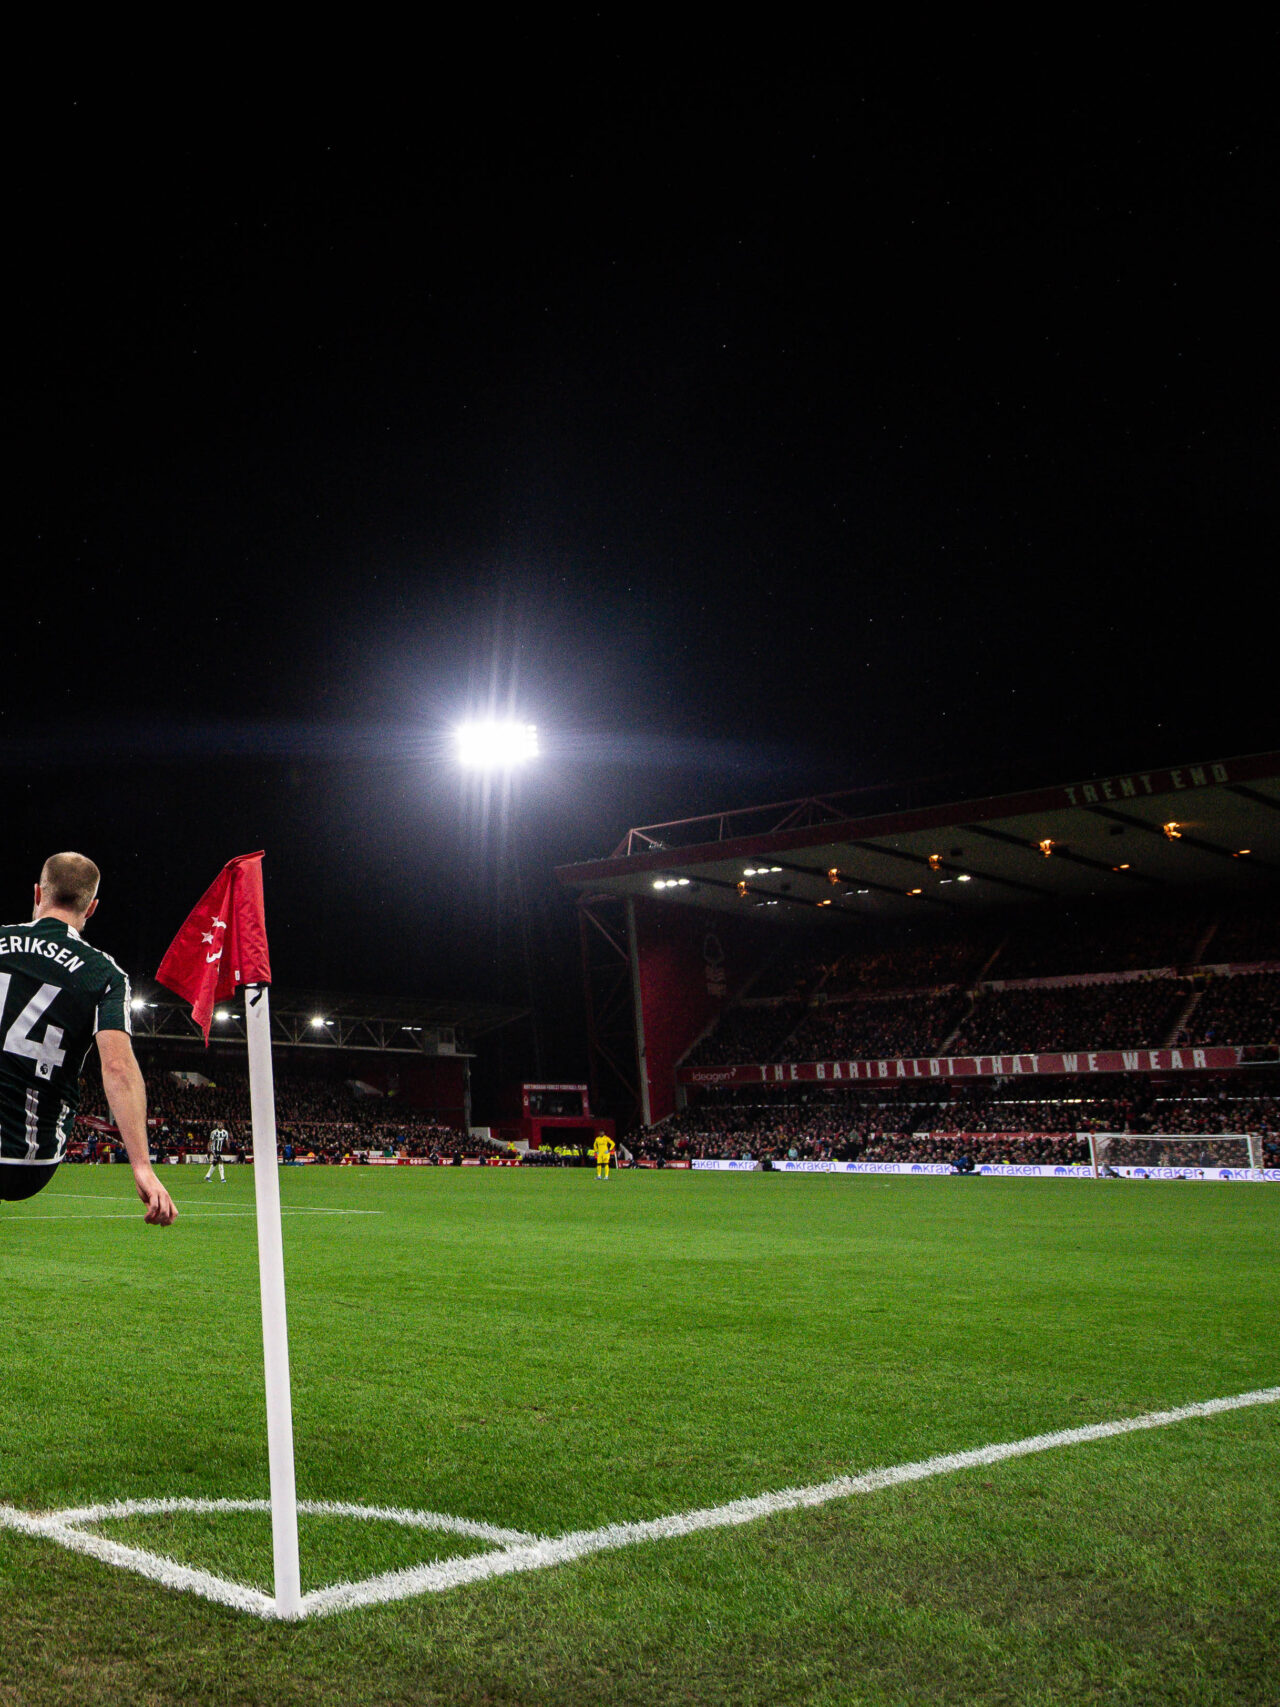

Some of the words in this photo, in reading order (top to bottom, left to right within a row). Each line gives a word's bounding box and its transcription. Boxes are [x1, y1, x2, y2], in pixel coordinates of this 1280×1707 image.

[1064, 775, 1153, 805] TRENT
[1169, 764, 1230, 789] END
[759, 1064, 799, 1081] THE
[816, 1058, 956, 1080] GARIBALDI
[973, 1056, 1040, 1075] THAT
[1062, 1053, 1099, 1072] WE
[1122, 1049, 1208, 1071] WEAR
[795, 1161, 837, 1171] kraken
[857, 1162, 901, 1172] kraken
[993, 1165, 1042, 1175] kraken
